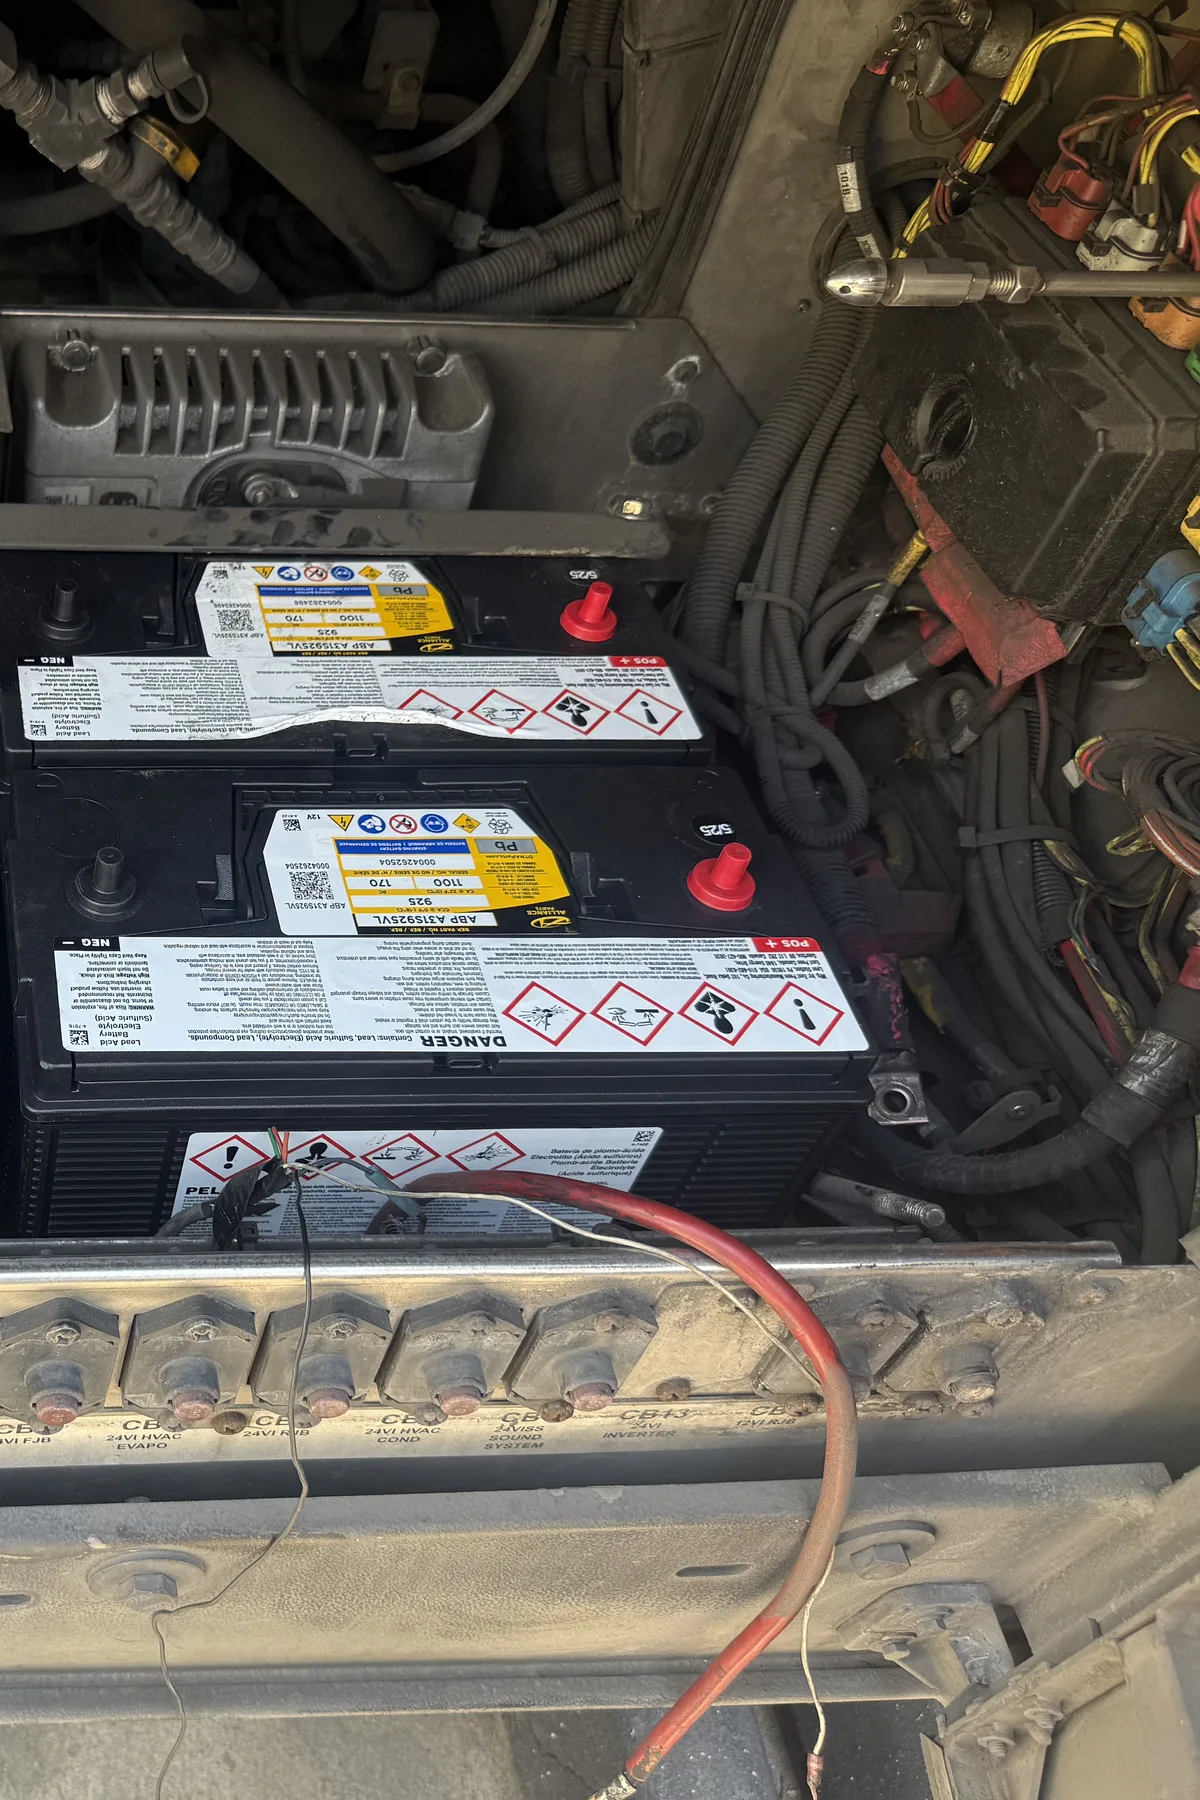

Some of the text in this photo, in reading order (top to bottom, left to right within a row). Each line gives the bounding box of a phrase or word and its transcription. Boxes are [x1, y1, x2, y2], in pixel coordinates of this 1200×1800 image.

[839, 170, 851, 196] 101B
[569, 570, 598, 580] 5/25
[392, 585, 413, 595] Pb
[286, 641, 374, 650] ABP A31S925VL
[40, 656, 66, 664] NEG
[699, 823, 733, 837] 5/25
[494, 840, 517, 852] Pb
[284, 862, 330, 870] 0004262504
[378, 858, 436, 867] 0004262504
[369, 878, 392, 887] 170
[433, 878, 463, 887] 1100
[284, 902, 328, 910] A31S925VL
[407, 897, 433, 906] 925
[372, 914, 477, 925] ABP A31S925VL
[81, 938, 110, 947] NEG
[781, 939, 810, 948] POS
[94, 1014, 153, 1022] (Sulfuric Acid)
[98, 1022, 141, 1030] Electrolyte
[99, 1030, 129, 1038] Battery
[419, 1035, 507, 1048] DANGER
[488, 1433, 542, 1441] SOUND
[602, 1429, 677, 1439] INVERTER
[116, 1442, 168, 1450] EVAPO
[483, 1442, 545, 1450] SYSTEM
